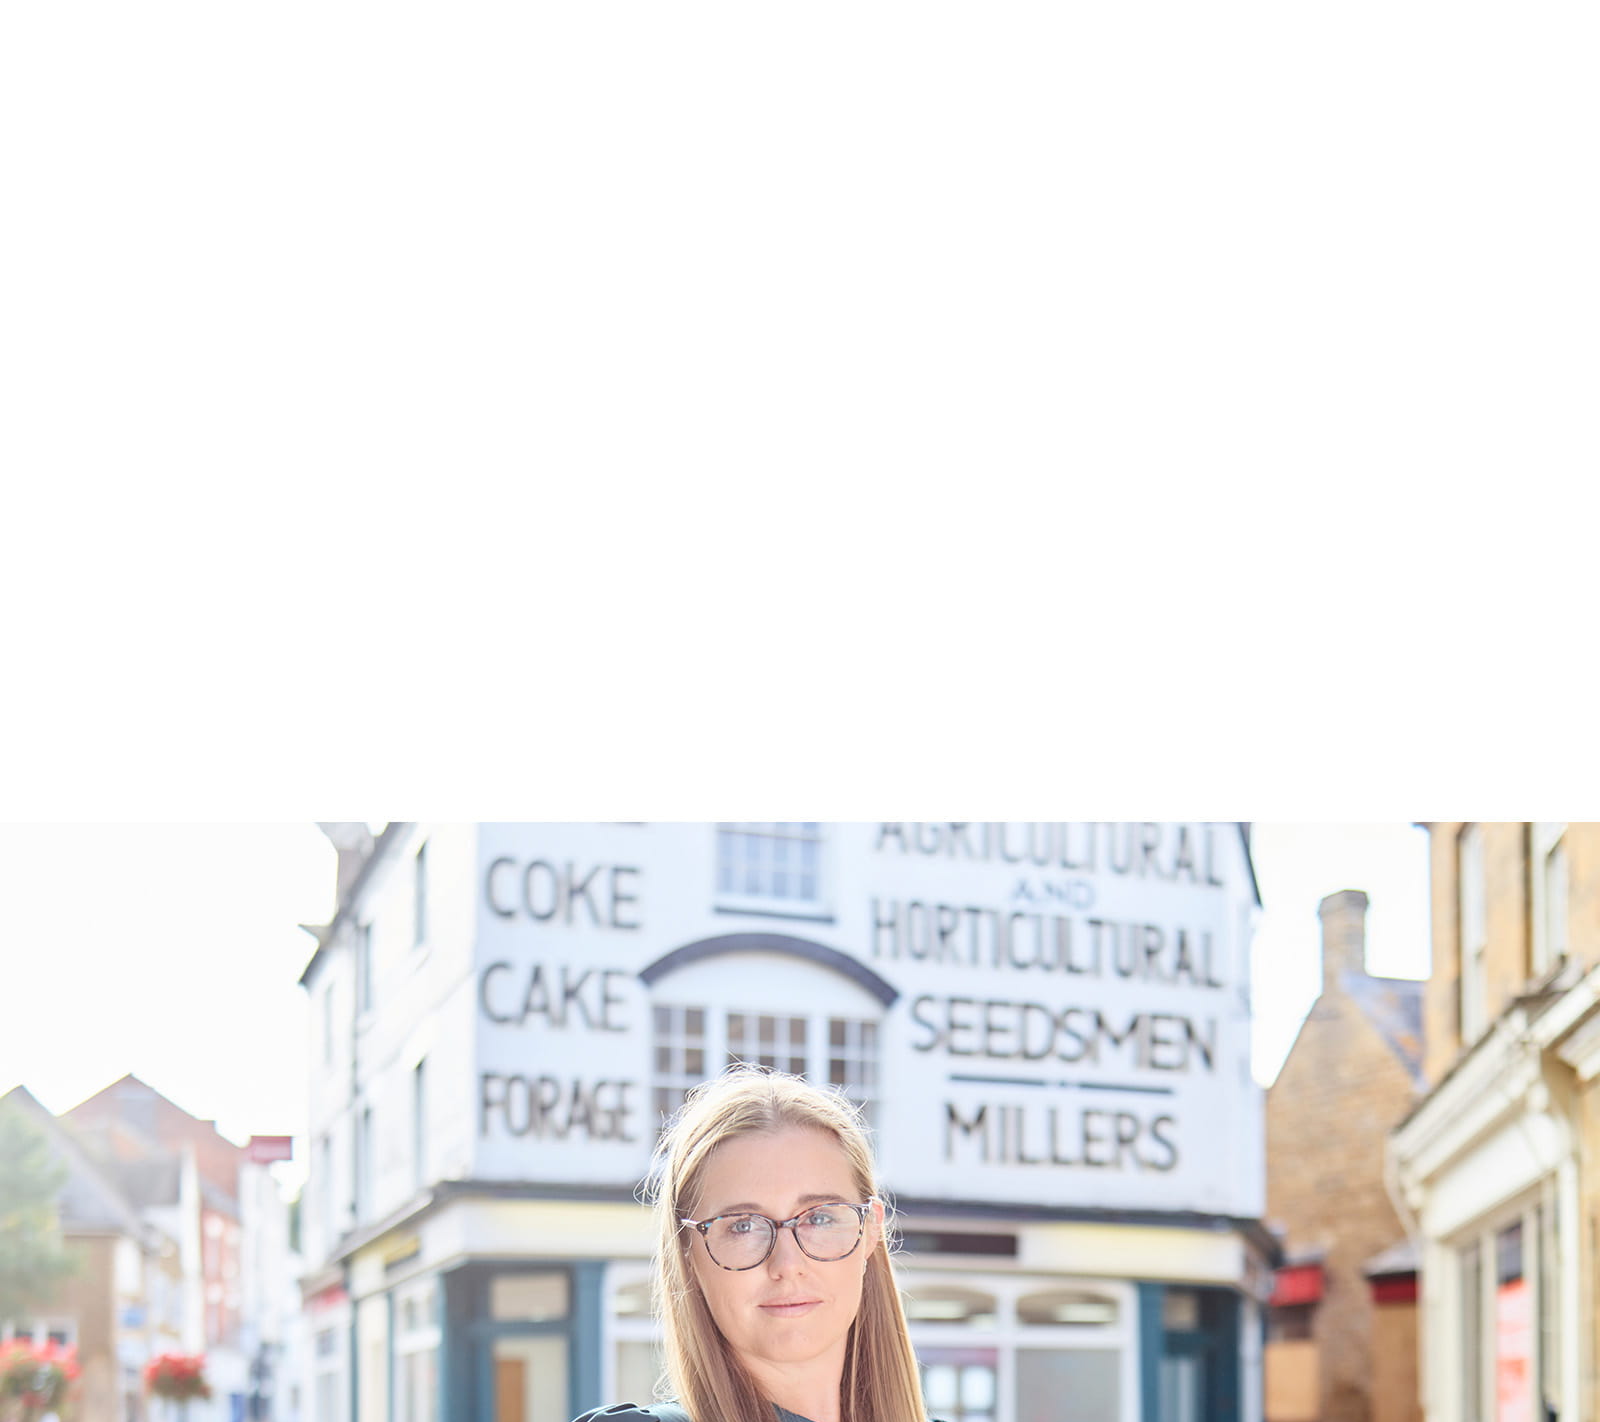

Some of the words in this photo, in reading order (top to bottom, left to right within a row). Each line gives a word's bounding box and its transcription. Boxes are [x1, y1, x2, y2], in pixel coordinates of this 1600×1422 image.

[485, 857, 642, 930] COKE
[1013, 879, 1097, 908] AND
[872, 898, 1224, 989] HORTICULTURAL
[478, 961, 629, 1032] CAKE
[911, 996, 1217, 1073] SEEDSMEN
[480, 1073, 635, 1143] FORAGE
[945, 1102, 1178, 1172] MILLERS
